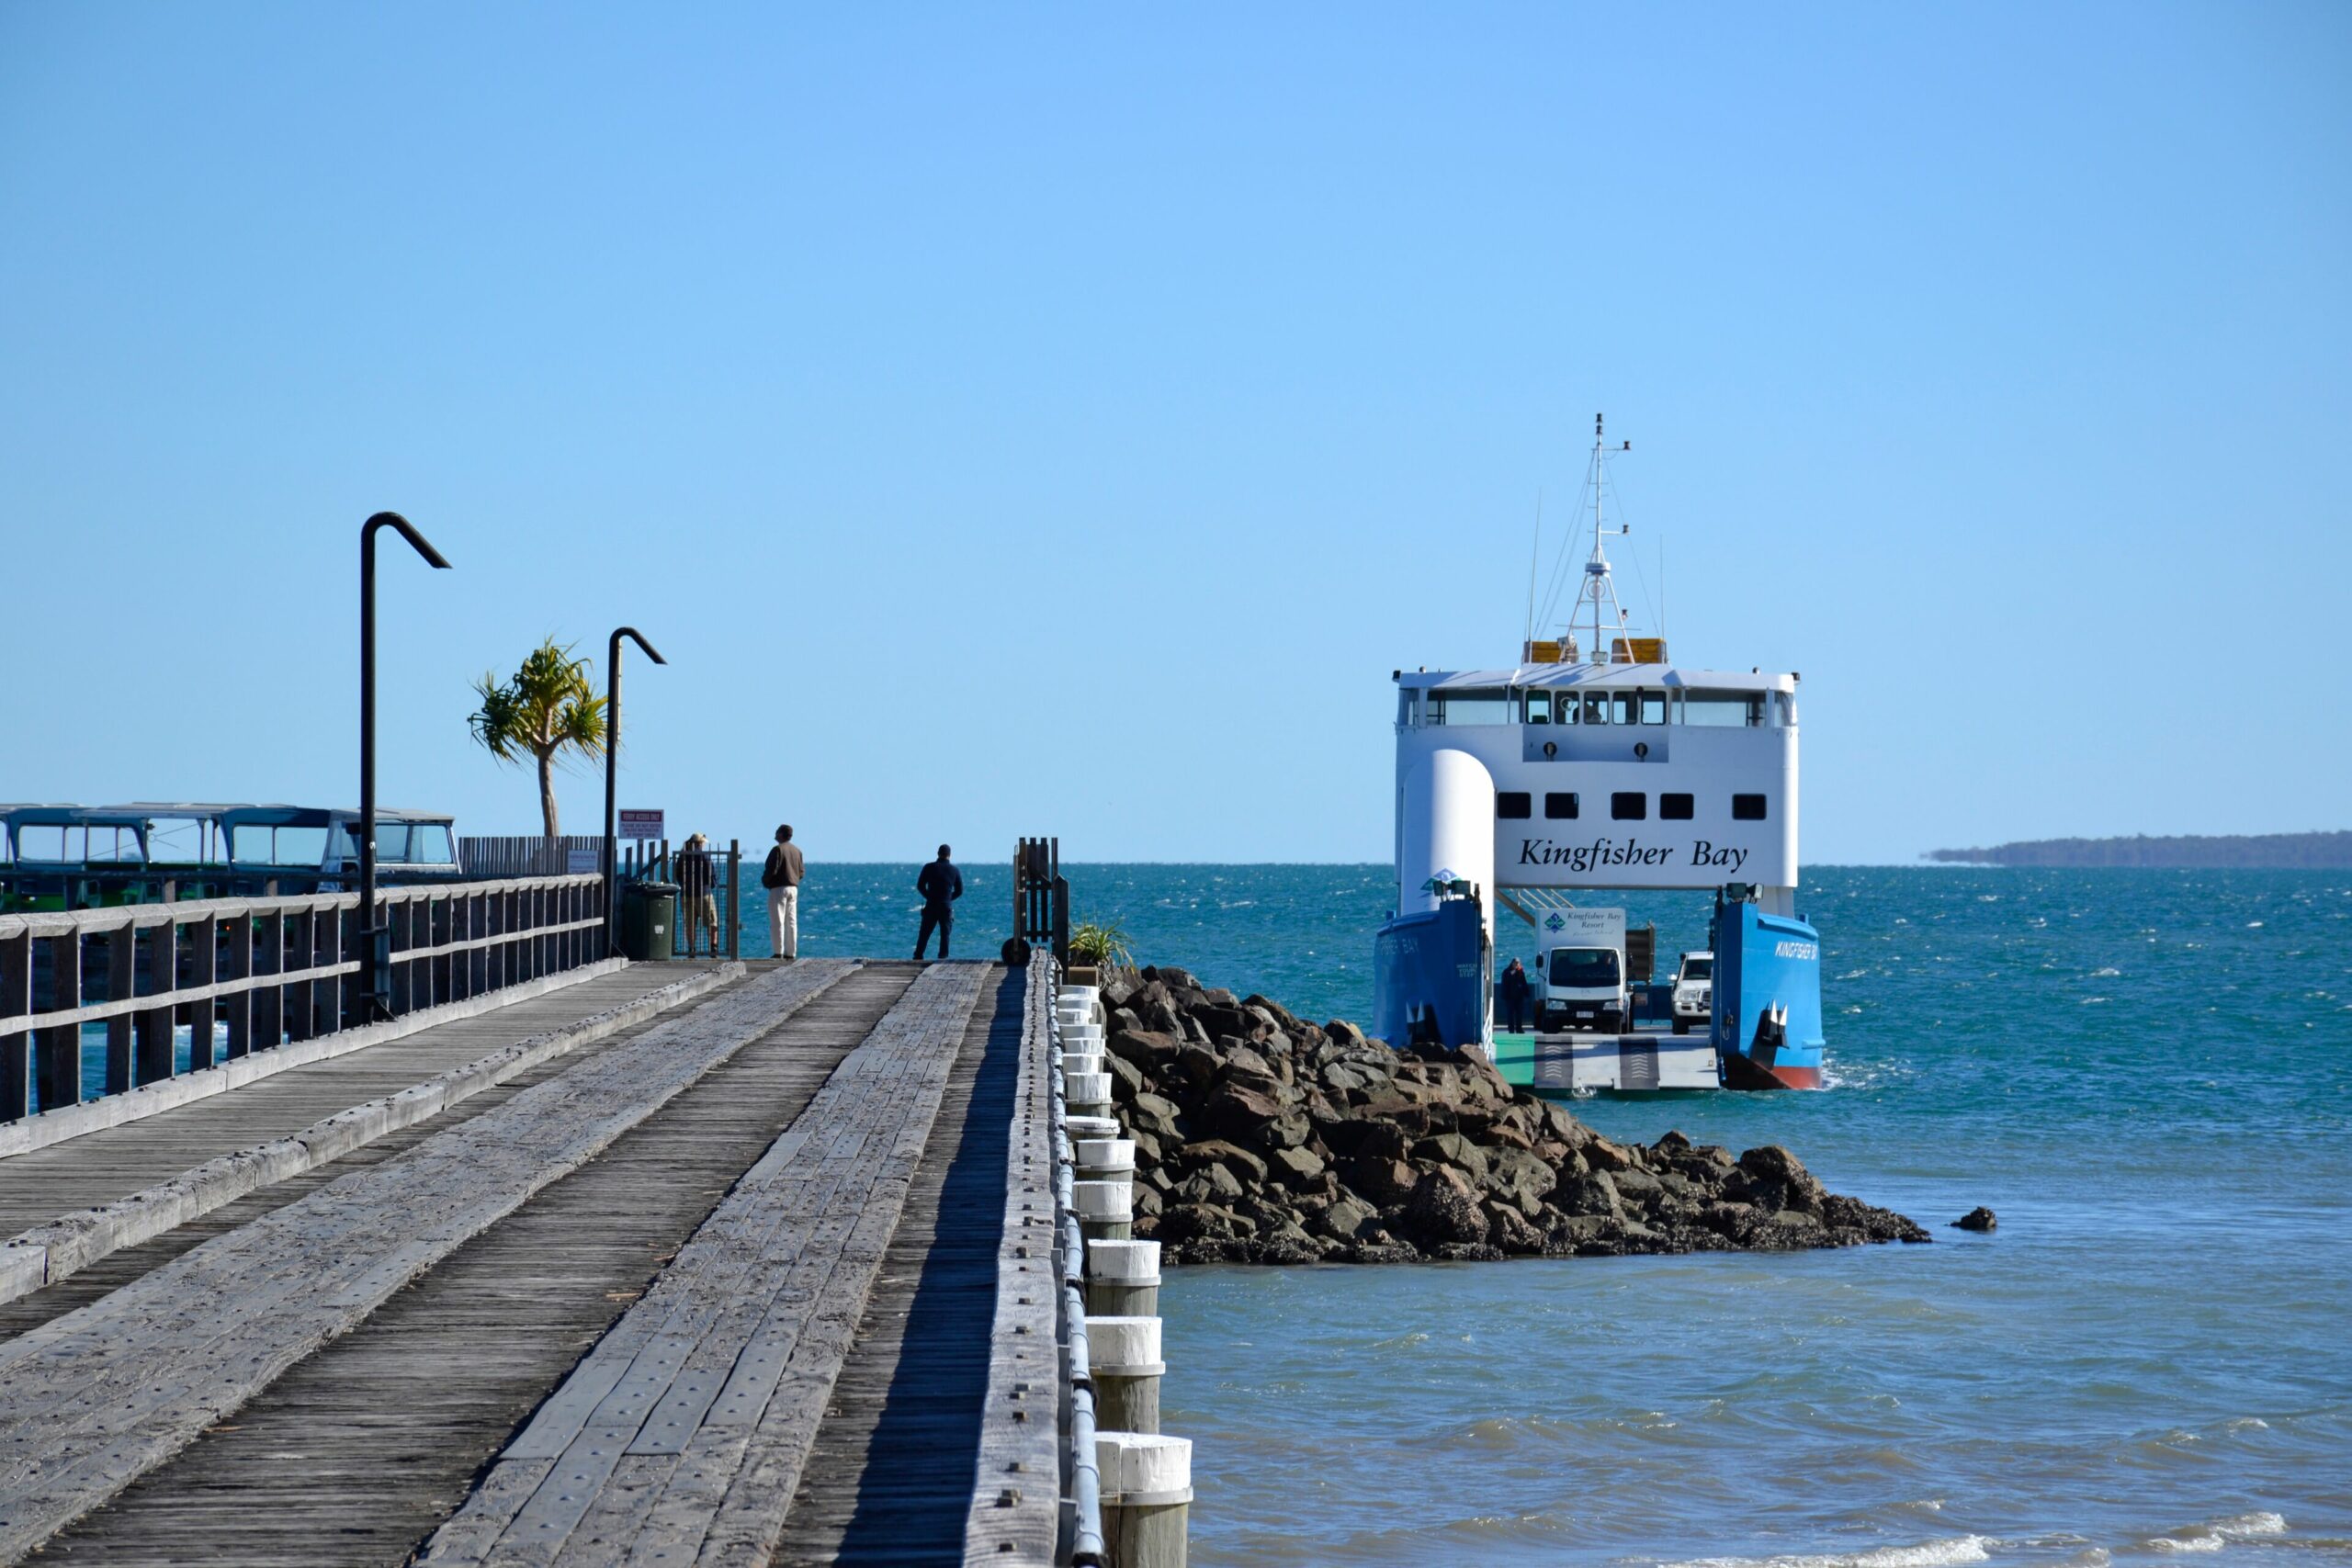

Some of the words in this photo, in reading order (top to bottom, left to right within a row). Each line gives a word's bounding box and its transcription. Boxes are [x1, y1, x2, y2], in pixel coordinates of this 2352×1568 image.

[1518, 838, 1673, 872] Kingfisher
[1690, 840, 1748, 874] Bay
[1401, 937, 1419, 954] BAY
